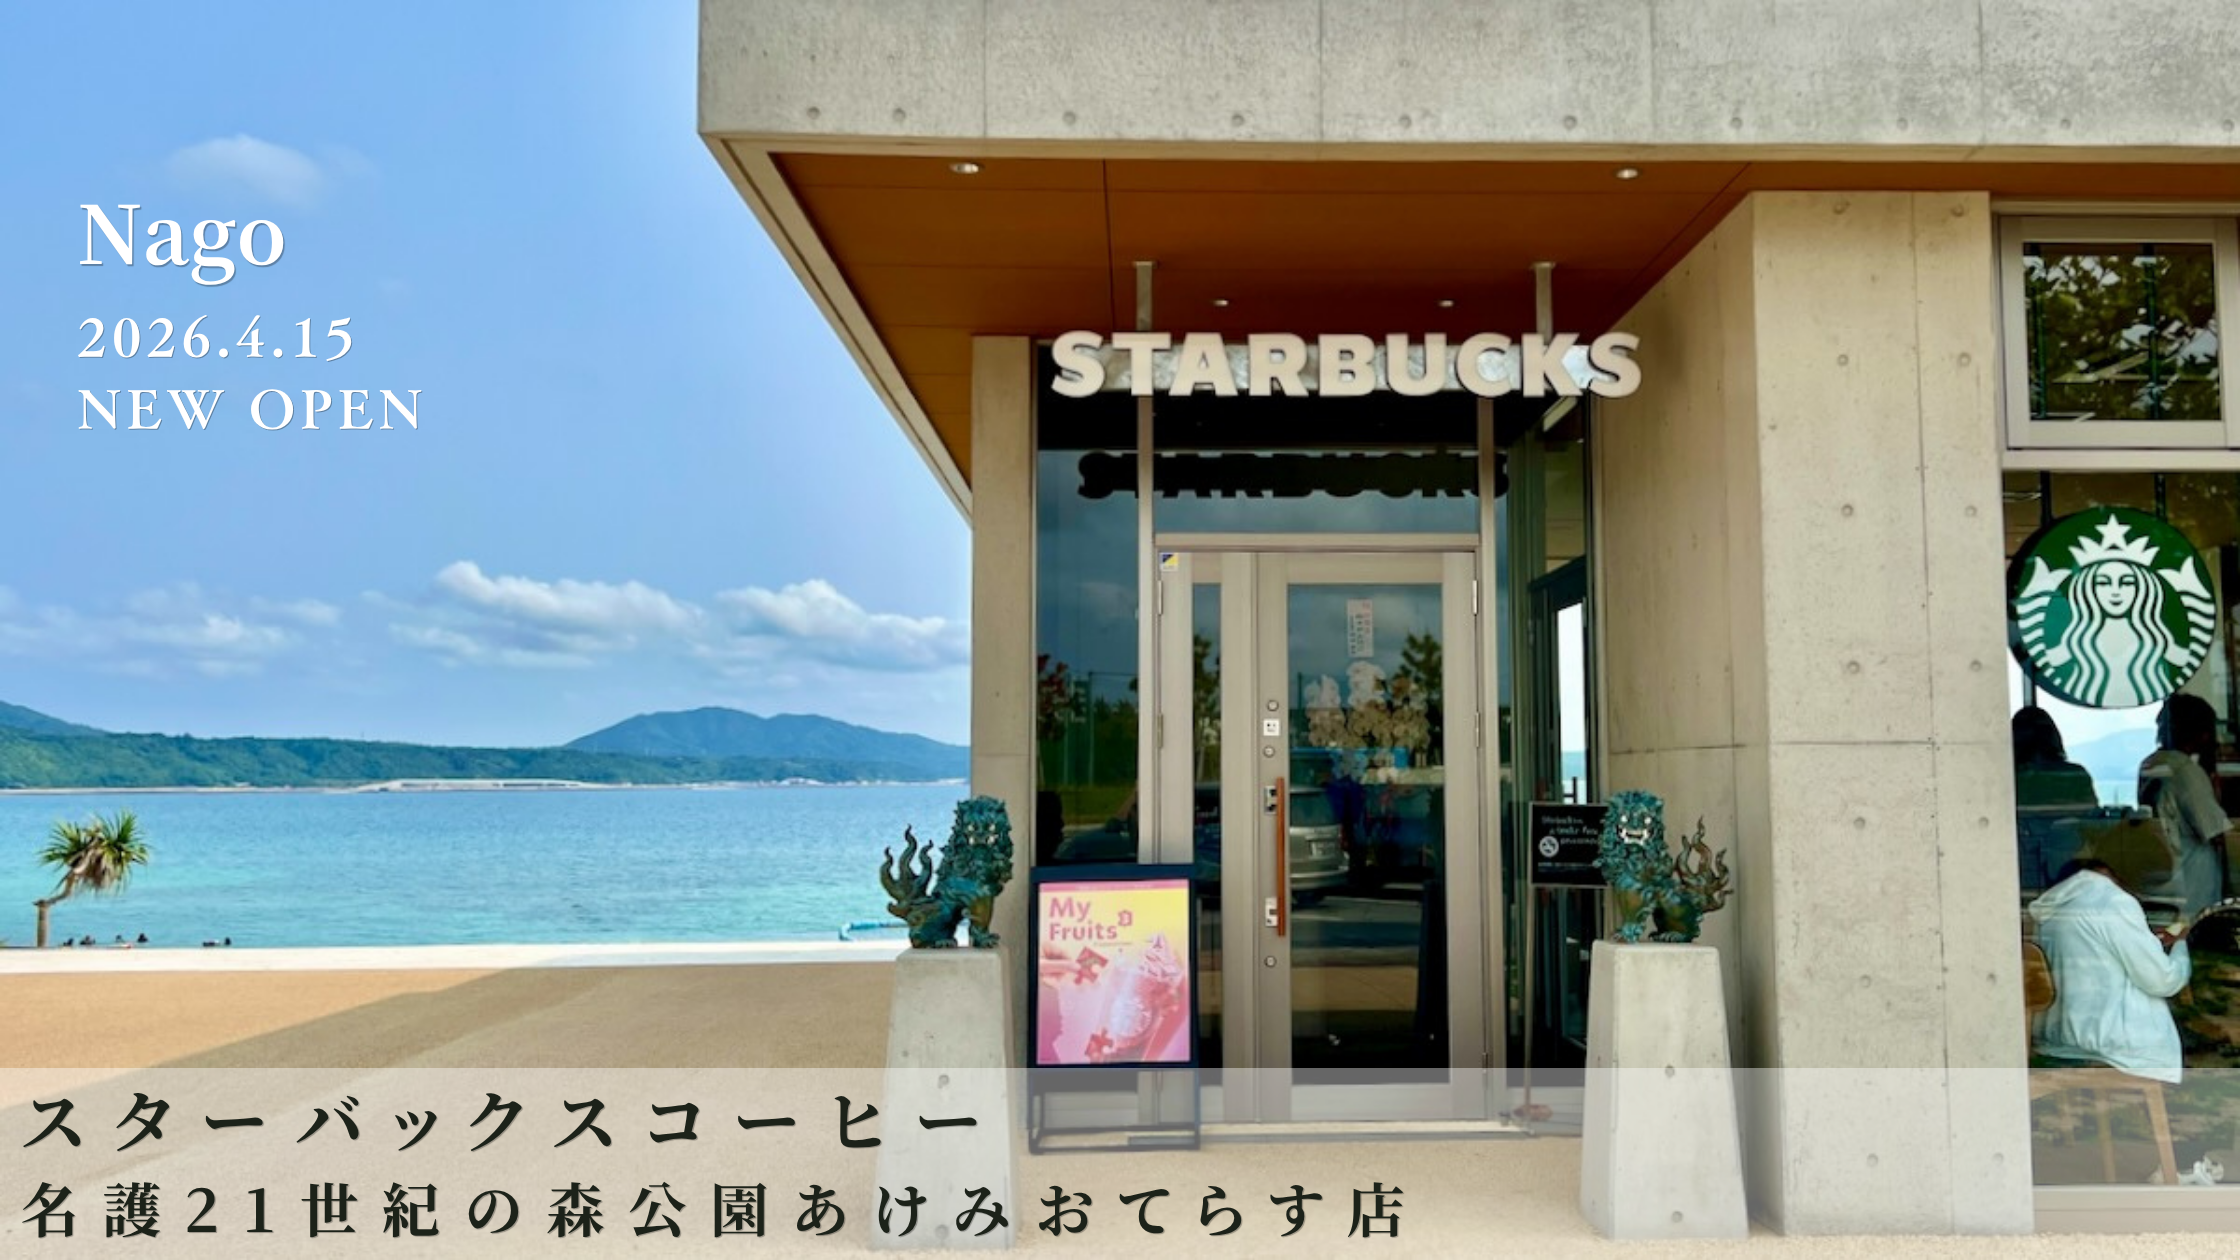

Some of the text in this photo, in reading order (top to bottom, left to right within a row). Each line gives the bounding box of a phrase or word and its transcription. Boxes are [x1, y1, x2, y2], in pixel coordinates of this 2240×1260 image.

[1051, 331, 1641, 397] STARBUCKS
[1049, 898, 1091, 921] My
[1049, 922, 1118, 941] Fruits
